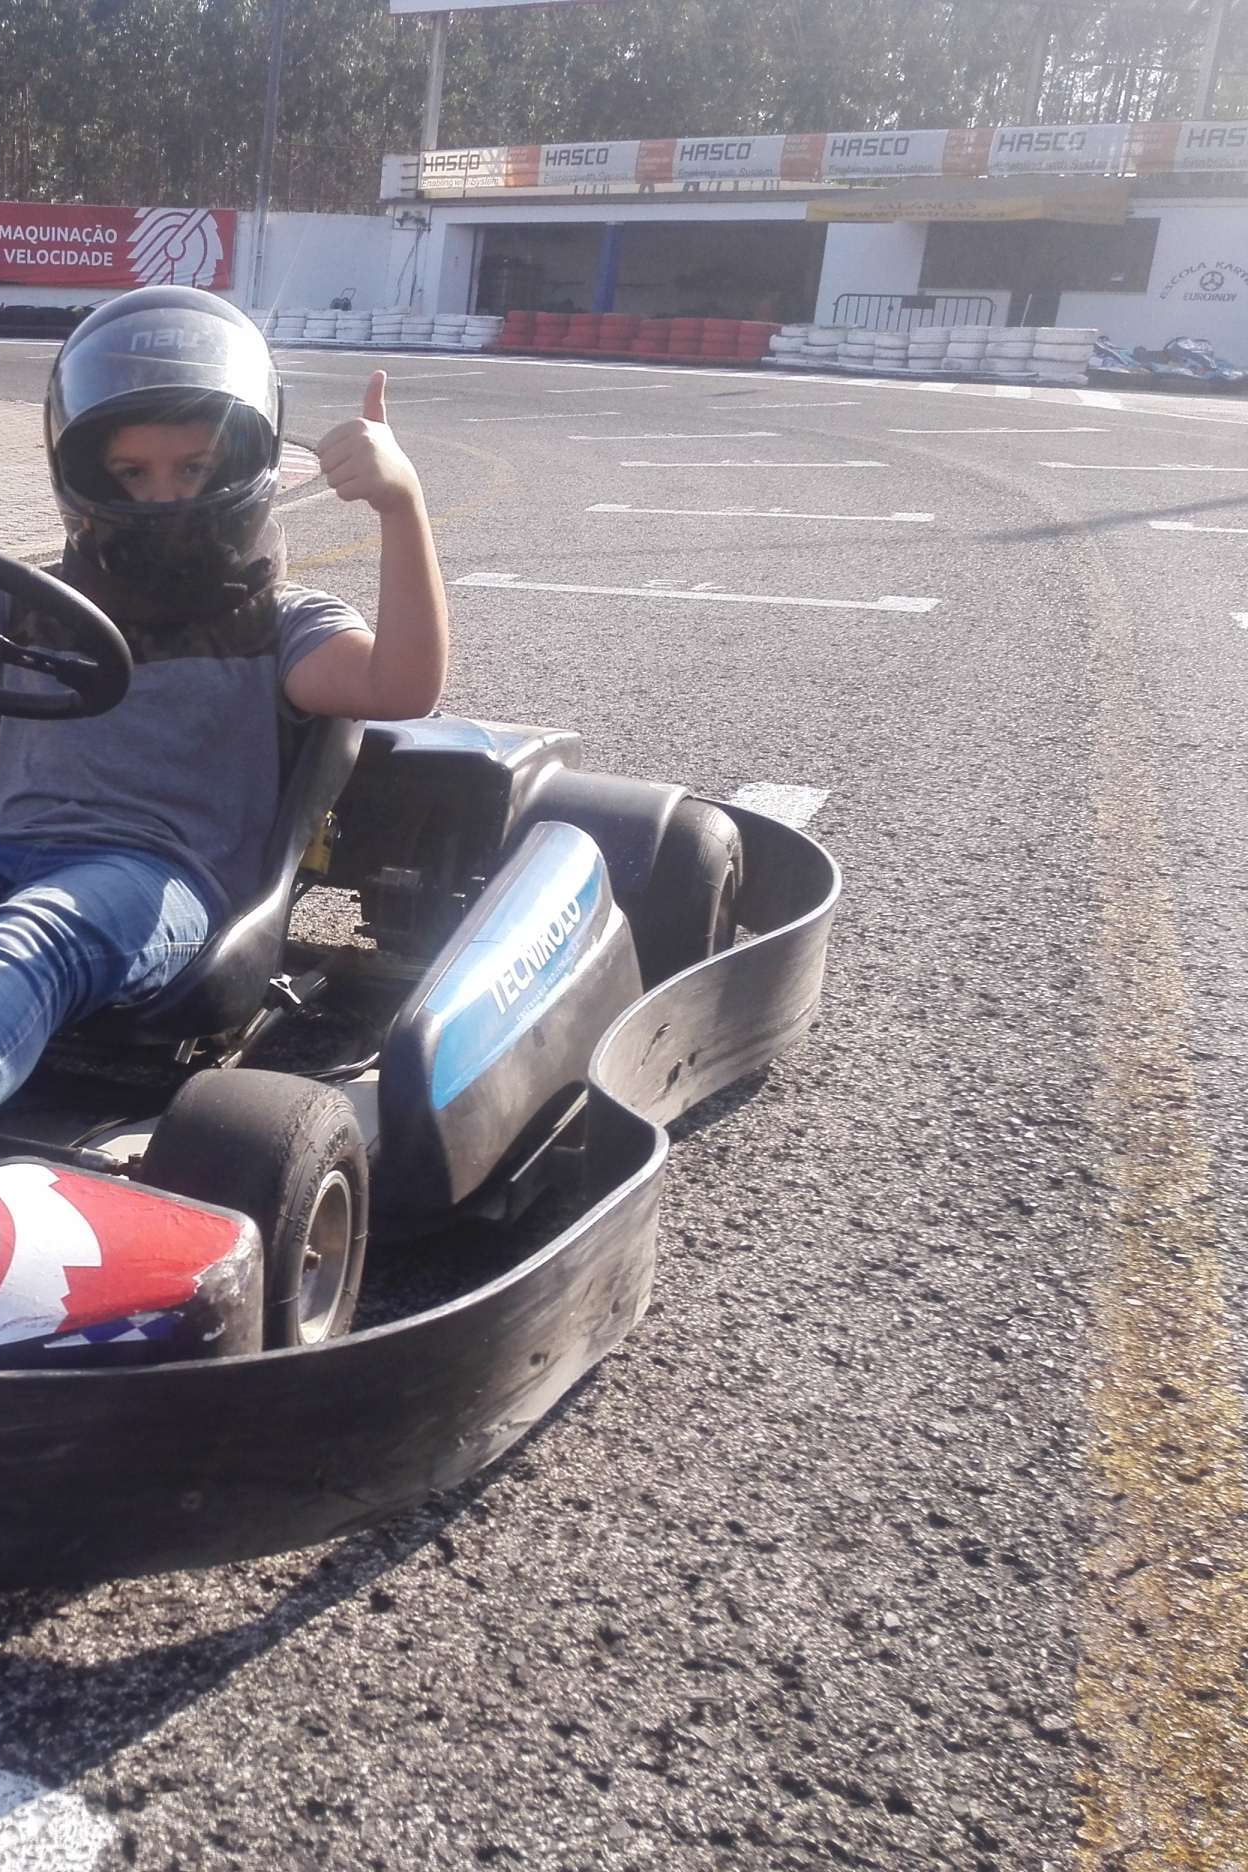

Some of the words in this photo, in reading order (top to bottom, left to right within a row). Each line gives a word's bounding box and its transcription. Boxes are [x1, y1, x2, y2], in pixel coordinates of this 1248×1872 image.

[830, 137, 910, 157] HASCO
[997, 131, 1087, 152] HASCO
[1186, 127, 1248, 148] HAS
[545, 148, 609, 167] HASCO
[680, 142, 752, 161] HASCO
[423, 154, 481, 172] HASCO
[3, 248, 113, 266] VELOCIDADE
[488, 897, 583, 1016] TECNIROLO
